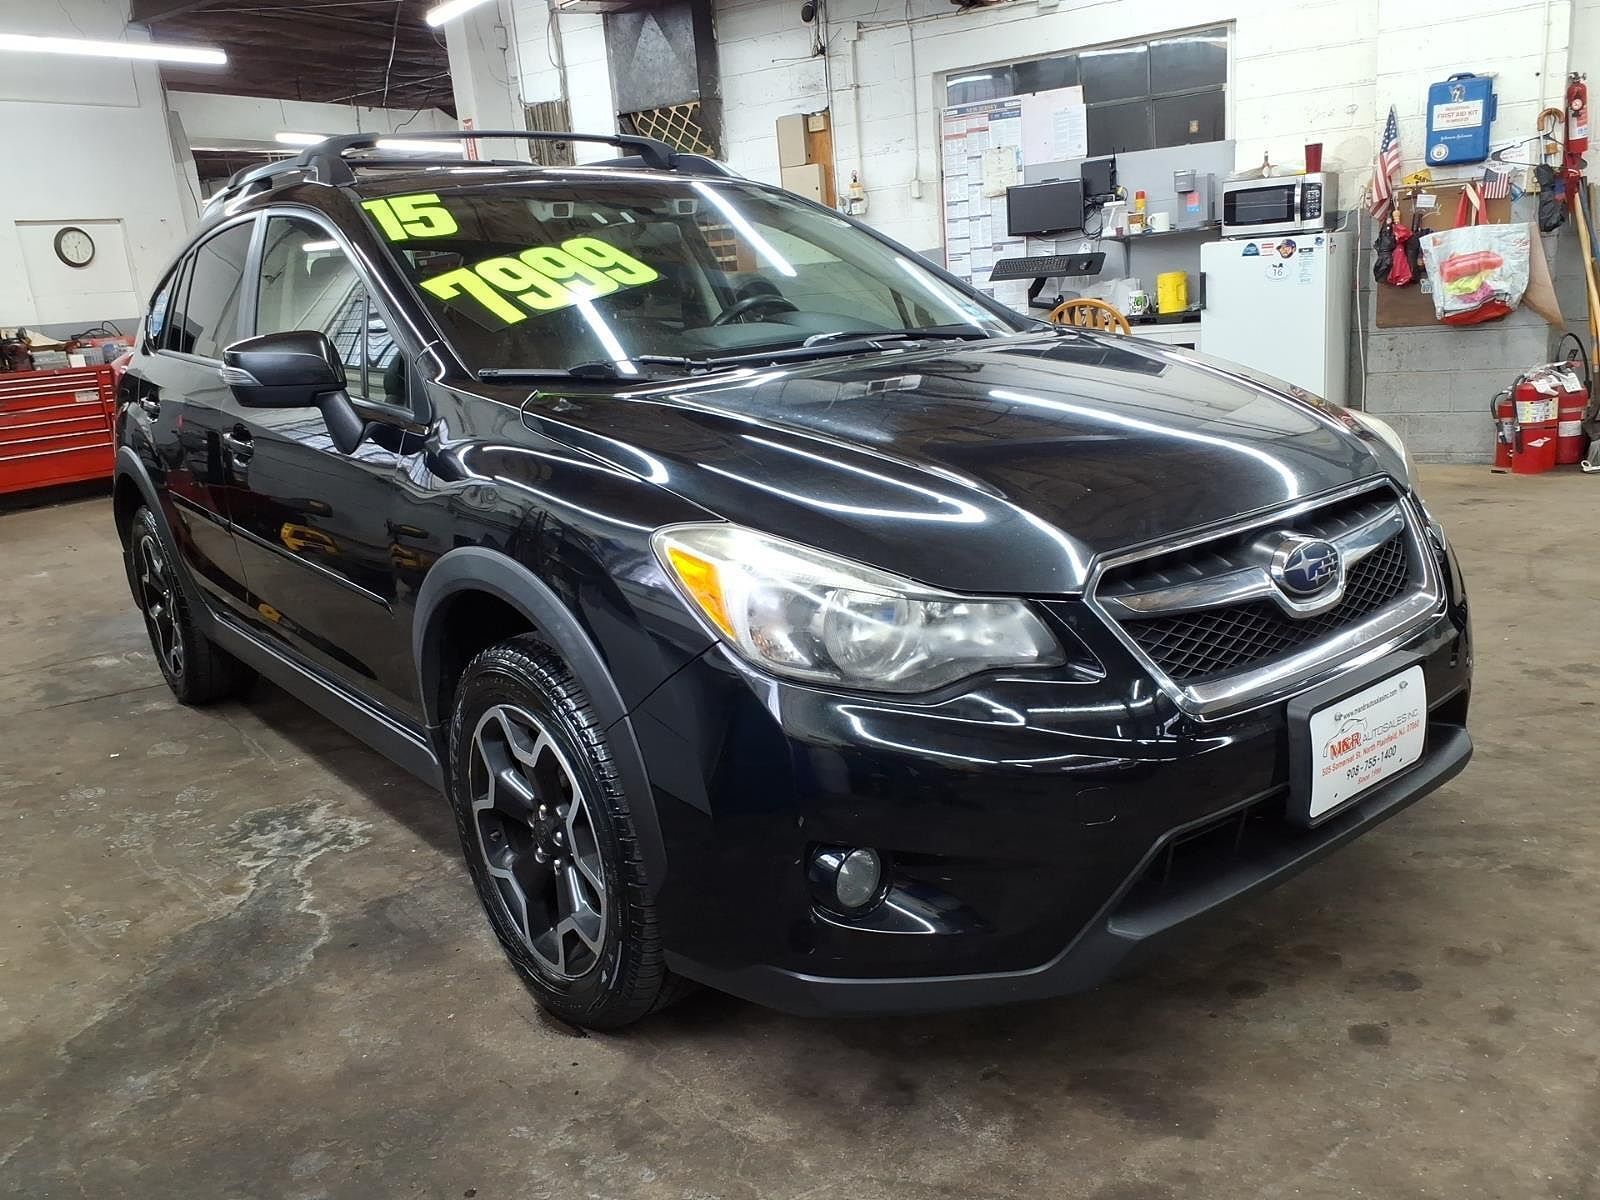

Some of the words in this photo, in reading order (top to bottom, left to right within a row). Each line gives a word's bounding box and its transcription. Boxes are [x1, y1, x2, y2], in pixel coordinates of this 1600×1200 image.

[361, 193, 459, 241] 15
[419, 237, 659, 325] 7999
[1273, 268, 1283, 277] 16
[1330, 731, 1362, 760] M&R
[1362, 743, 1376, 756] North
